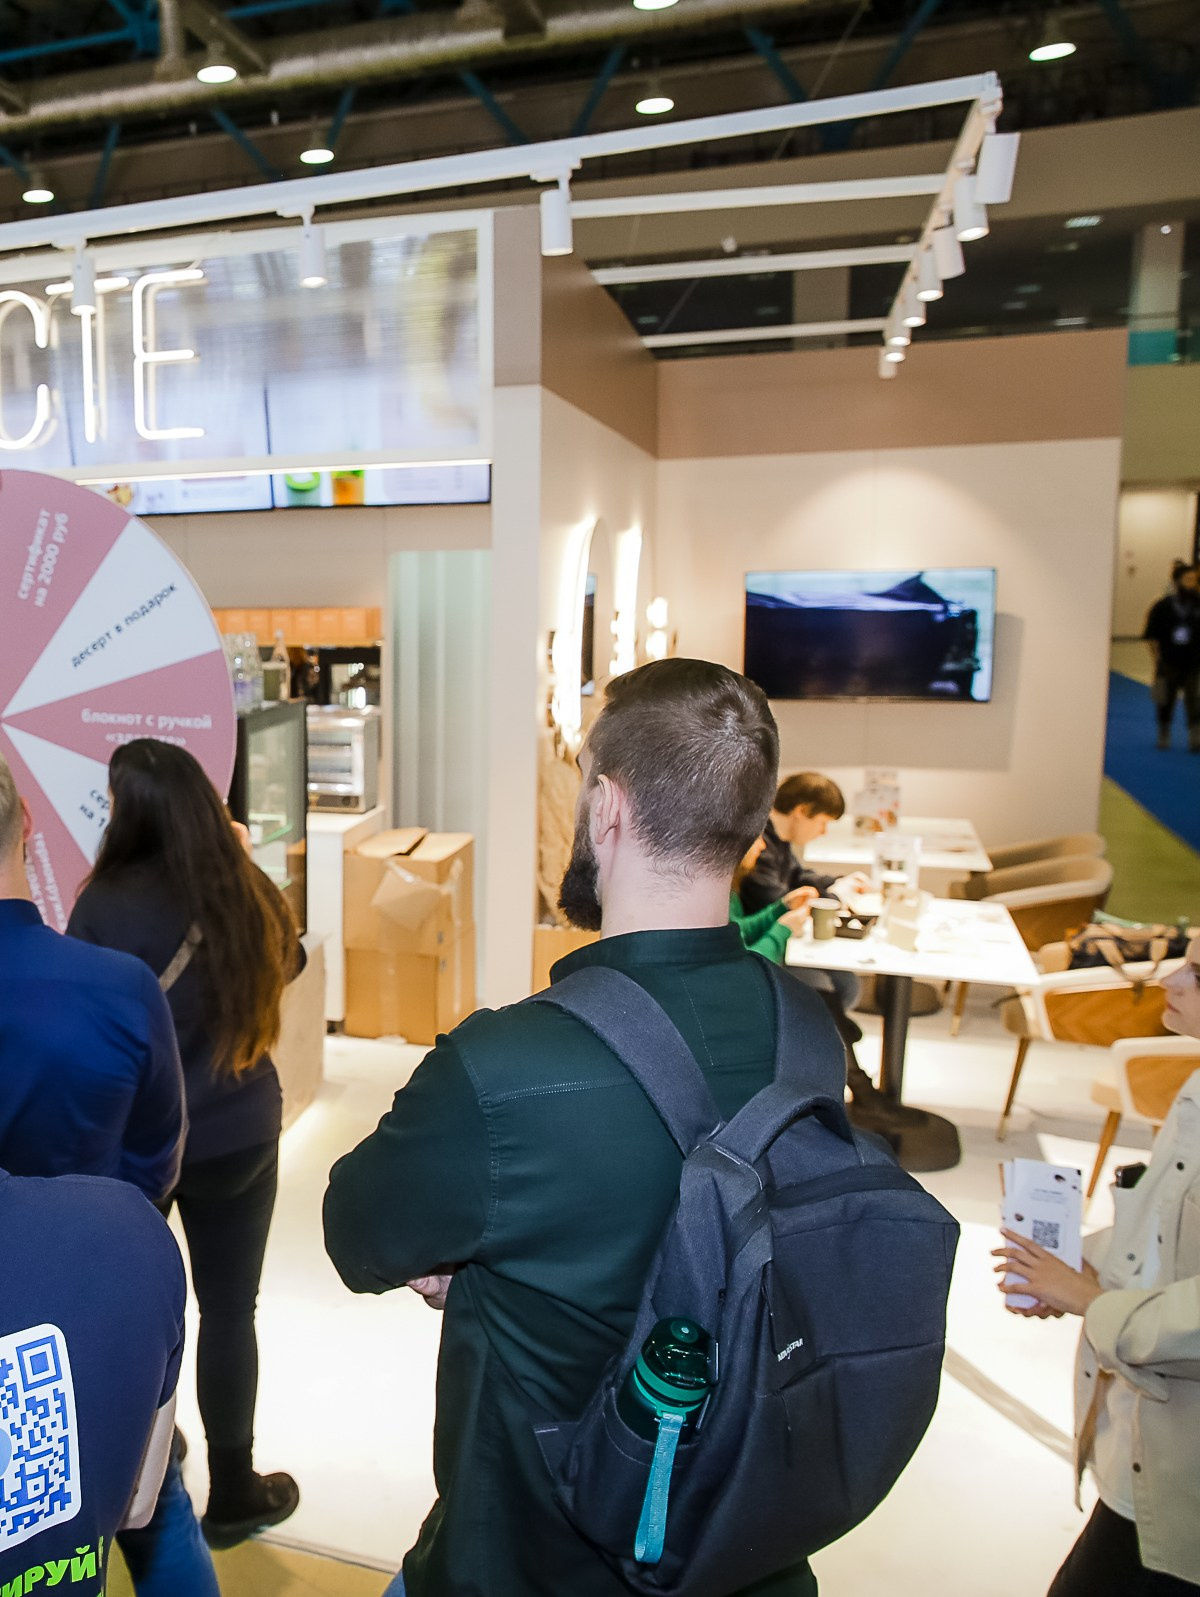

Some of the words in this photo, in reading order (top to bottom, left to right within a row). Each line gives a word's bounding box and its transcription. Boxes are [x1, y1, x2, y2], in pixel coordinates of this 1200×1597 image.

[52, 511, 69, 543] руб
[17, 508, 51, 600] сертификат
[38, 543, 60, 585] 2000
[34, 586, 48, 608] на
[71, 630, 114, 668] десерт
[114, 623, 124, 634] в
[123, 581, 178, 627] подарок
[81, 708, 143, 725] блокнот
[145, 714, 155, 727] с
[157, 715, 212, 731] ручкой
